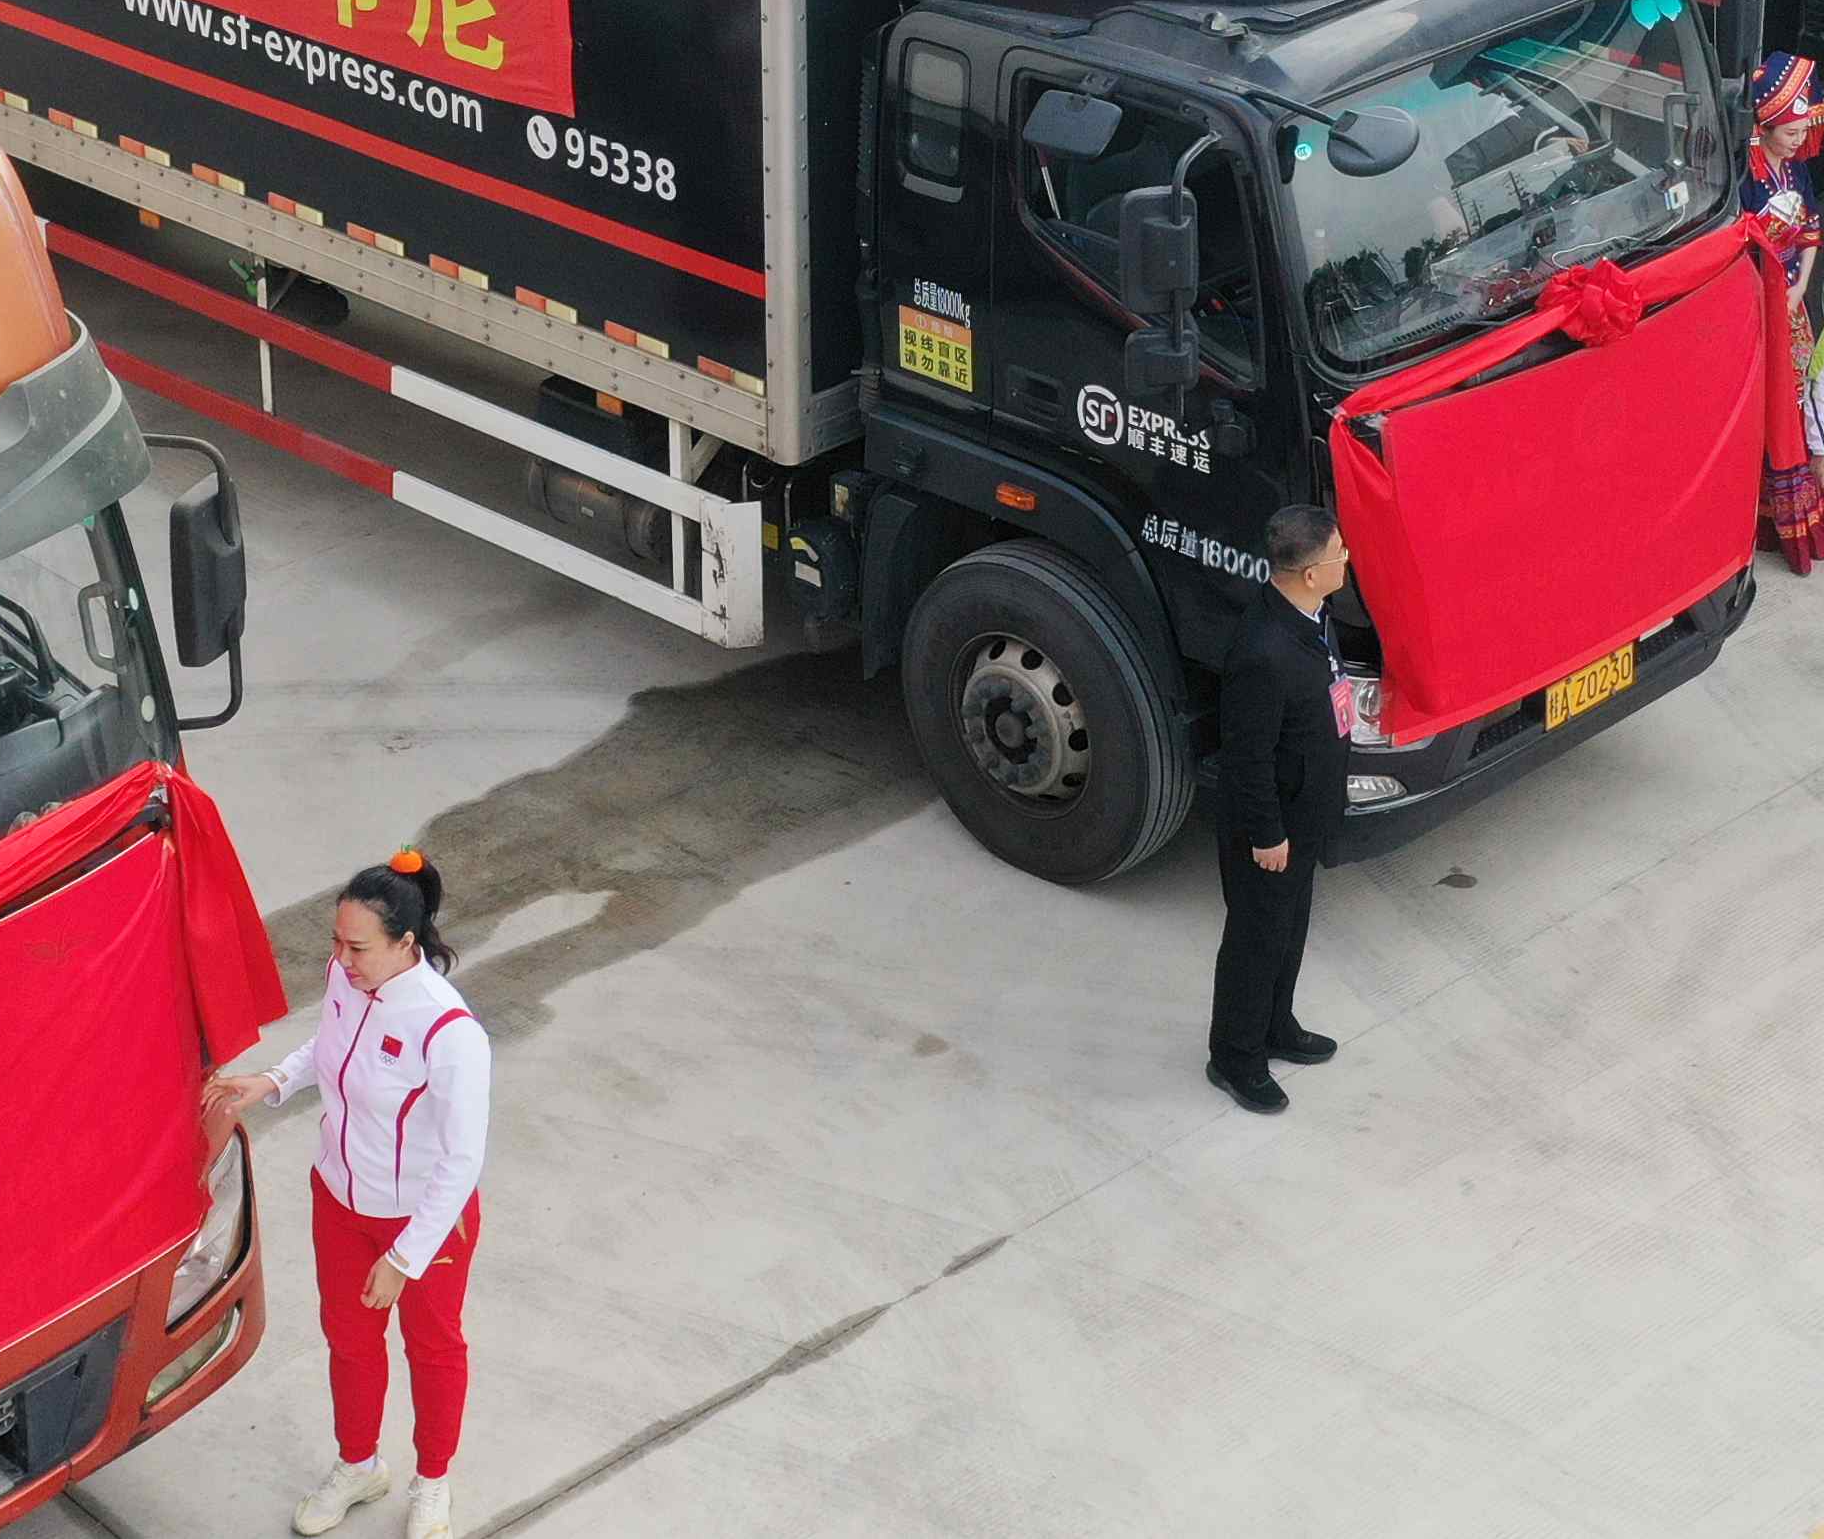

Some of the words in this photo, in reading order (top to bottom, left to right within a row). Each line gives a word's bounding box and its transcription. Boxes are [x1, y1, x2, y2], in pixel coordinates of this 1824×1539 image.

[564, 127, 678, 201] 95338
[1128, 428, 1211, 474] 顺丰速运
